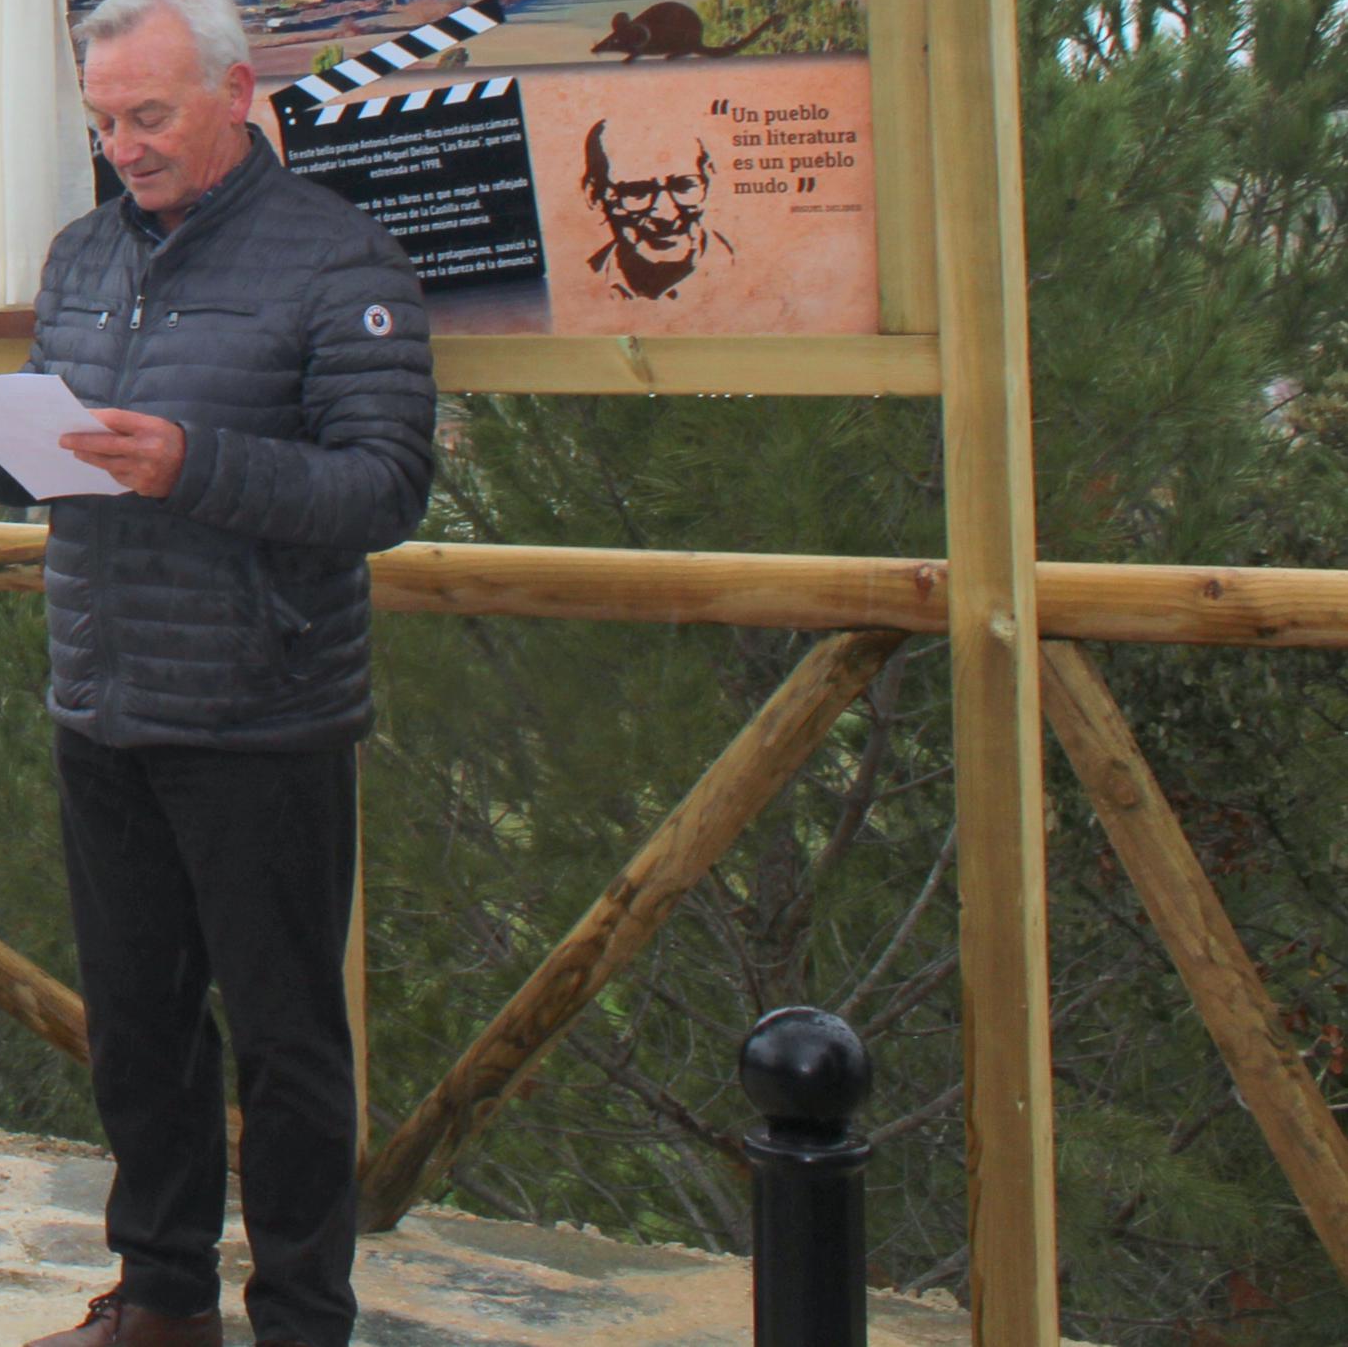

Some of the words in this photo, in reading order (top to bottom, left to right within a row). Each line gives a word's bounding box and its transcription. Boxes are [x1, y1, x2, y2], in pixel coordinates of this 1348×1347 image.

[765, 104, 829, 125] pueblo
[289, 150, 299, 161] En
[299, 149, 315, 159] este
[316, 145, 335, 157] bello
[336, 143, 358, 154] paraje
[360, 138, 389, 149] Antonio
[485, 118, 519, 130] cámaras
[732, 131, 761, 146] sin
[766, 129, 856, 145] literatura
[309, 161, 337, 173] adaptar
[347, 156, 372, 166] novela
[373, 153, 382, 163] de
[383, 149, 409, 162] Miguel
[409, 146, 439, 157] Delibes
[485, 137, 499, 147] que
[733, 158, 753, 170] es
[759, 157, 784, 169] un
[789, 152, 854, 172] pueblo
[370, 165, 409, 178] estrenada
[409, 164, 420, 173] en
[372, 199, 381, 209] de
[383, 199, 397, 207] los
[398, 195, 421, 205] libros
[423, 193, 434, 201] en
[436, 190, 451, 200] que
[453, 187, 477, 197] mejor
[479, 184, 489, 193] ha
[492, 177, 527, 191] reflejado
[733, 177, 788, 194] mudo
[383, 212, 407, 222] drama
[409, 209, 419, 219] de
[421, 208, 429, 217] la
[429, 204, 459, 216] Castilla
[409, 226, 419, 234] en
[431, 220, 458, 230] misma
[426, 253, 435, 262] el
[527, 239, 537, 248] la
[437, 267, 445, 276] la
[447, 265, 473, 275] dureza
[475, 261, 485, 271] de
[487, 260, 495, 269] la
